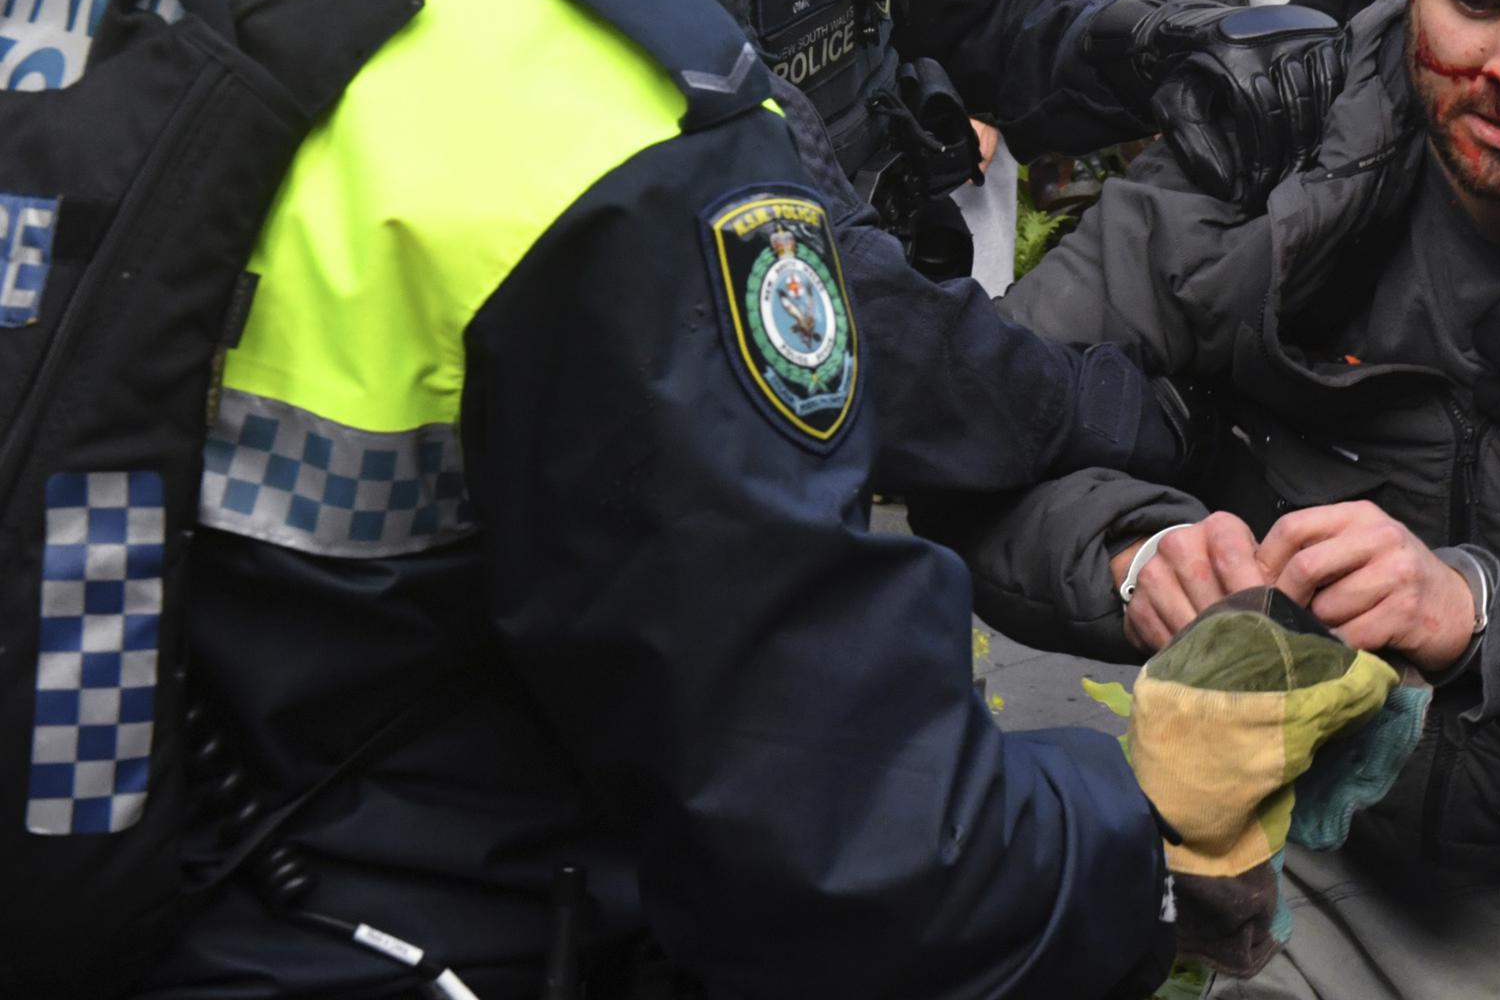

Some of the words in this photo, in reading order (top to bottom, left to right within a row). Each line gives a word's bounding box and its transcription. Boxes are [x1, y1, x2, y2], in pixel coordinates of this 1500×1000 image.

[773, 19, 855, 85] POLICE
[798, 25, 829, 49] SOUTH
[831, 6, 855, 31] WALES
[0, 204, 53, 308] E
